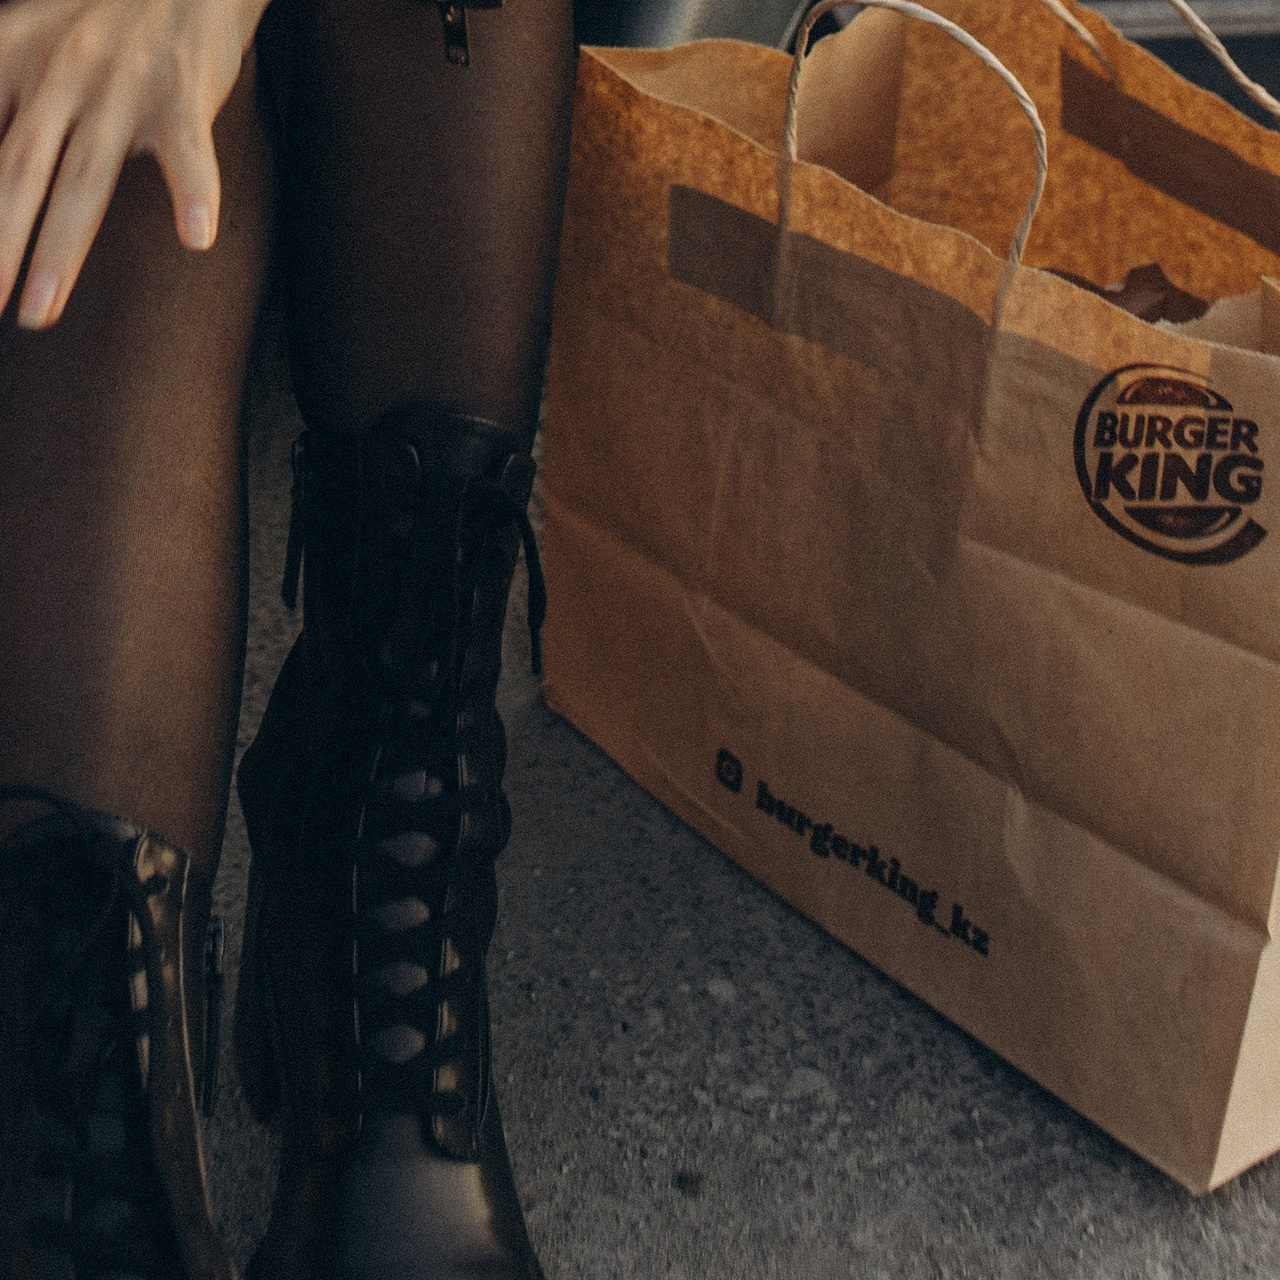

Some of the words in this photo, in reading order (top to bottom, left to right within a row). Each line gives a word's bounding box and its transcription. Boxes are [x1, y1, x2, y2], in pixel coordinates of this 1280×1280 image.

[1093, 411, 1260, 454] BURGER
[1093, 451, 1265, 506] KING
[755, 779, 990, 958] burgerking_kz
